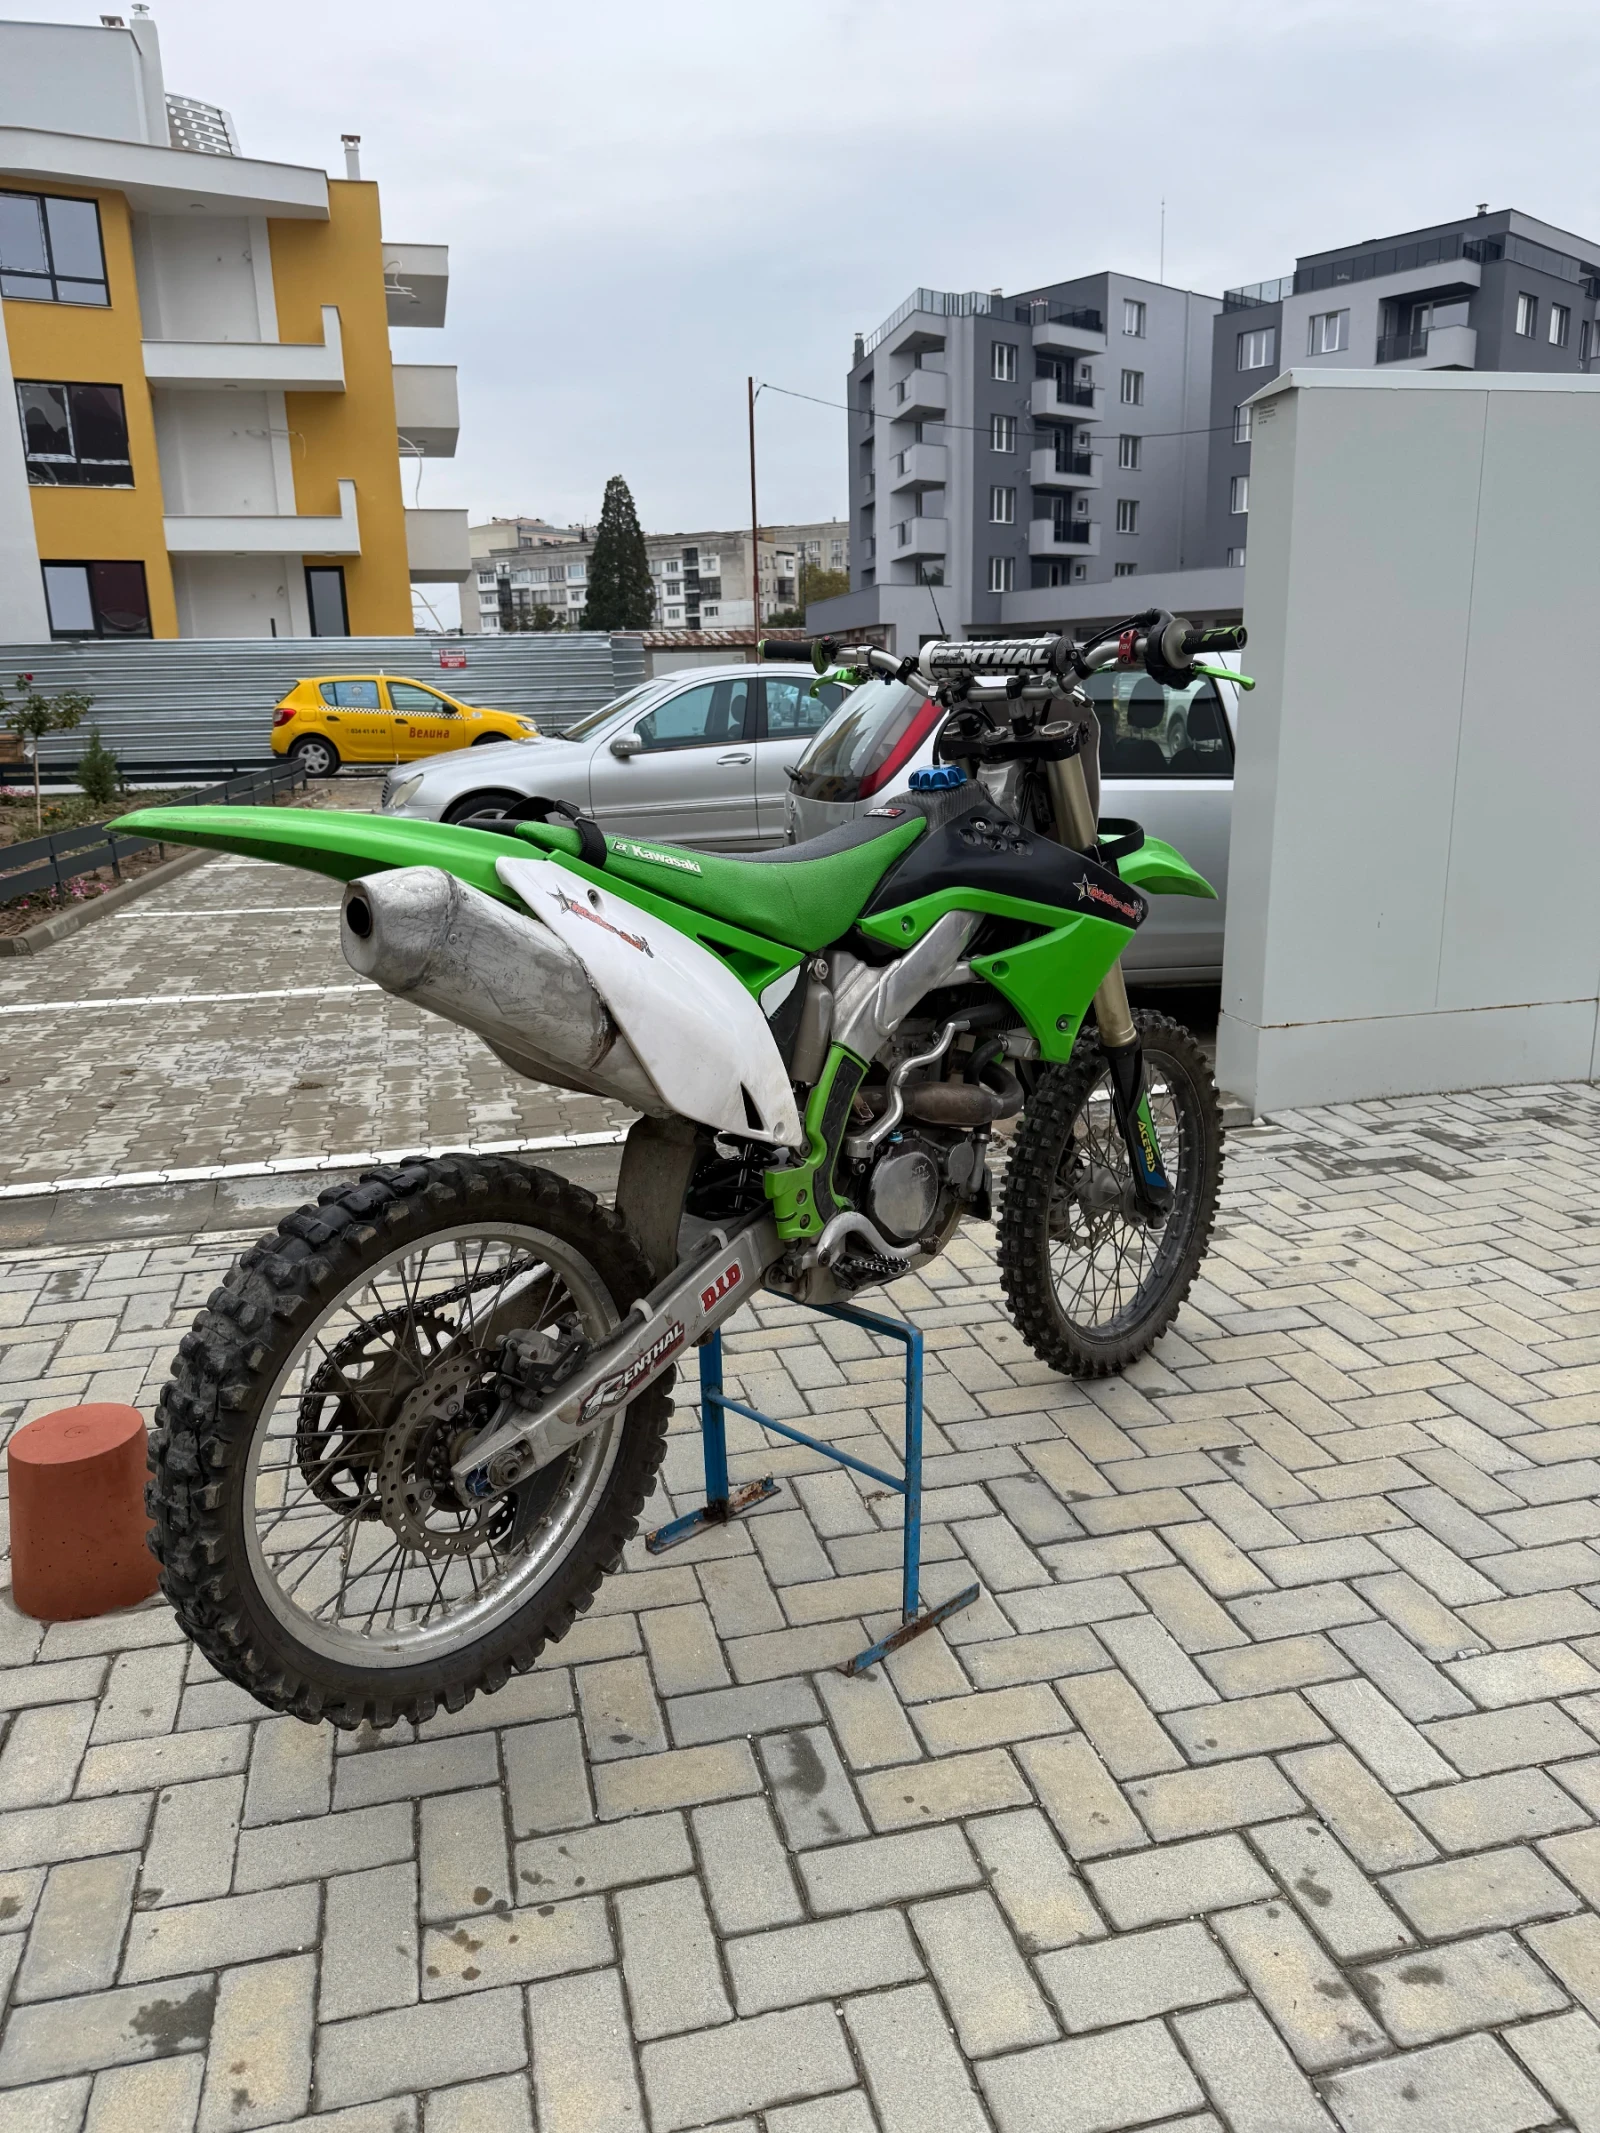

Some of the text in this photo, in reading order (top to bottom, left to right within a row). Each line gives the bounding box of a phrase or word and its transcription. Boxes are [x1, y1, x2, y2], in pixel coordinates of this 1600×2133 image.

[931, 648, 1049, 665] RENTHAL
[409, 727, 450, 739] Велина
[631, 844, 702, 874] Kawasaki
